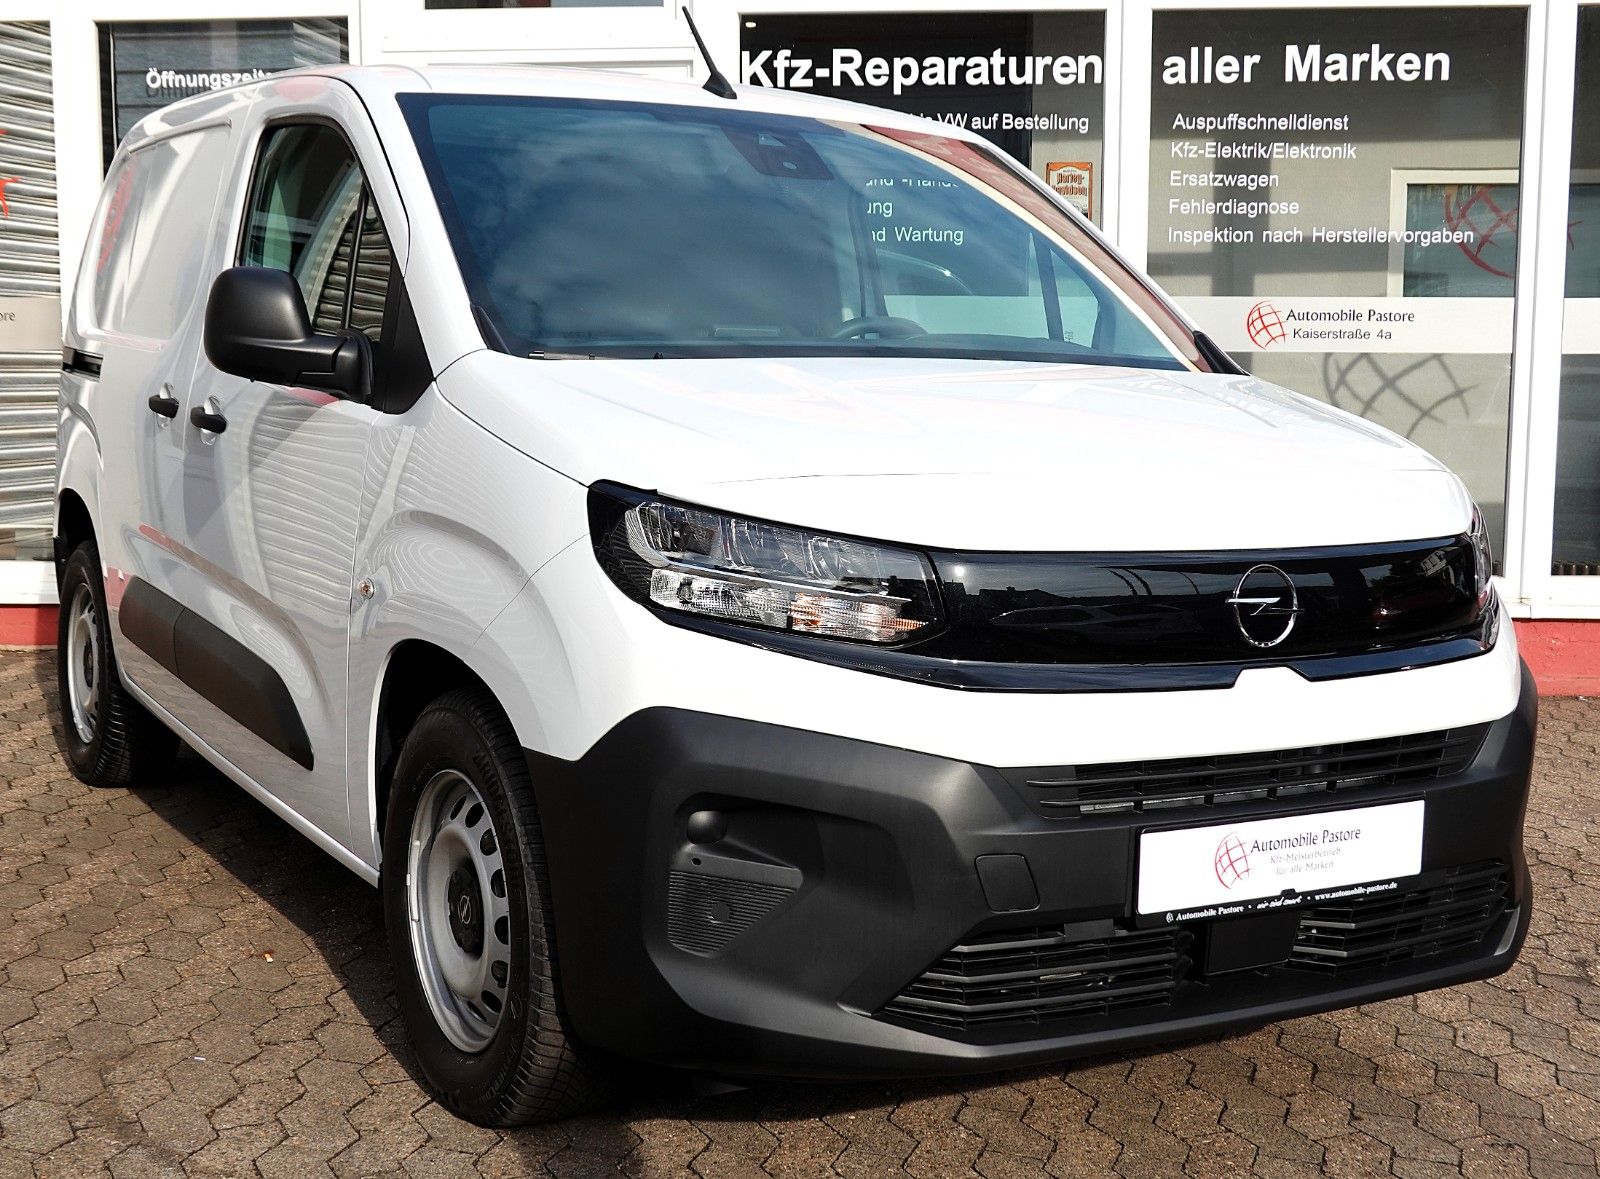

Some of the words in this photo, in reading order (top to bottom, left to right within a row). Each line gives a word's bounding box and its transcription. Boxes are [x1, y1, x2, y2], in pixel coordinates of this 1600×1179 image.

[741, 48, 1102, 95] Kfz-Reparaturen
[1162, 46, 1261, 84] aller
[1284, 44, 1451, 82] Marken
[971, 113, 998, 130] auf
[1002, 113, 1089, 133] Bestellung
[1173, 113, 1349, 133] Auspuffschnelldienst
[1171, 142, 1357, 160] Kfz-Elektrik/Elektronik
[1170, 170, 1279, 190] Ersatzwagen
[1169, 199, 1300, 218] Fehlerdiagnose
[894, 226, 964, 246] Wartung
[1168, 227, 1253, 247] Inspektion
[1262, 227, 1303, 243] nach
[1312, 227, 1474, 247] Herstellervorgaben
[1286, 308, 1363, 322] Automobile
[1368, 308, 1415, 322] Pastore
[1293, 328, 1371, 340] Kaiserstraße
[1376, 328, 1392, 340] 4a
[1250, 831, 1319, 854] Automobile
[1322, 828, 1361, 844] Pastore
[1270, 846, 1341, 864] Kfz-Meisterbetrieb
[1305, 860, 1334, 872] Marken
[1176, 908, 1217, 921] Automobile
[1218, 905, 1245, 915] Pastore
